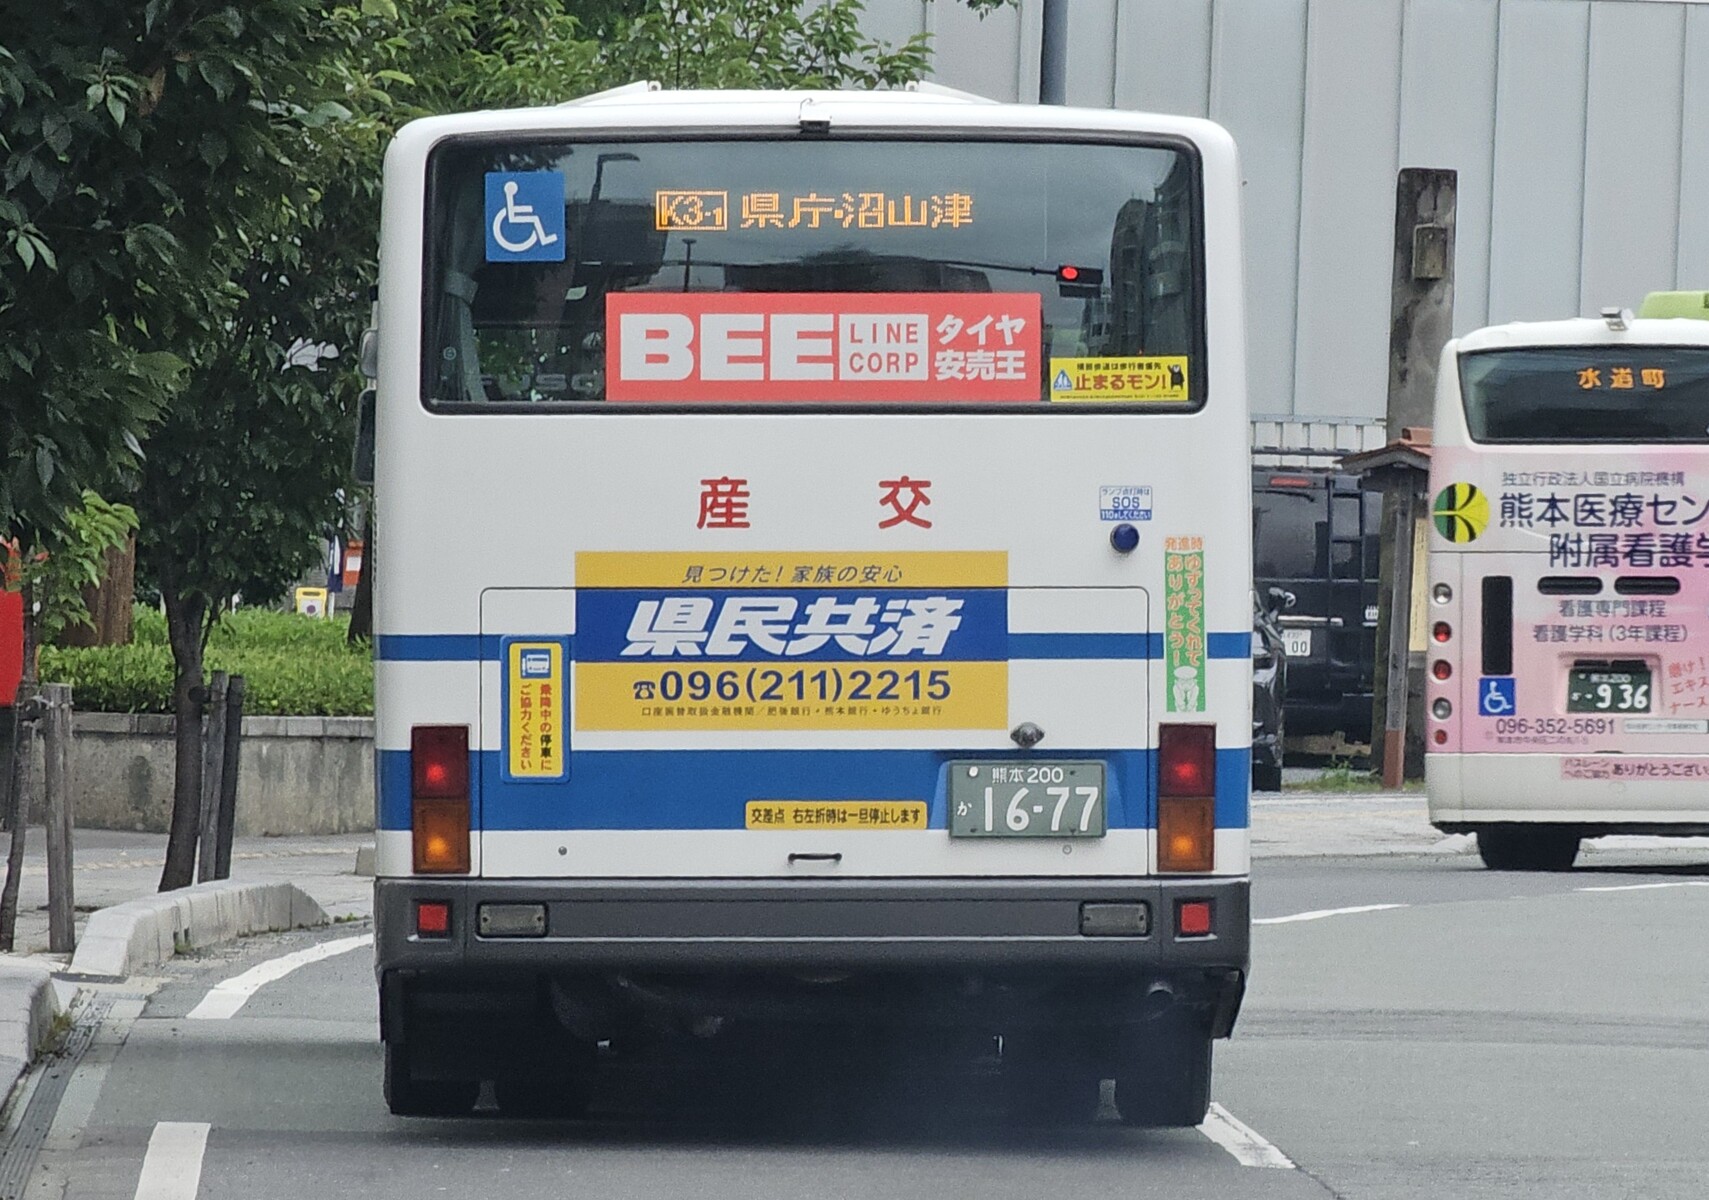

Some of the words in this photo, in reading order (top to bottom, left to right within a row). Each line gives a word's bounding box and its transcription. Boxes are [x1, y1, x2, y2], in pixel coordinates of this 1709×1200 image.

[660, 195, 723, 226] K3-1
[741, 192, 973, 228] 県庁・沼山津
[850, 323, 919, 344] LINE
[935, 314, 1026, 345] タイヤ
[620, 314, 834, 381] BEE
[850, 352, 919, 373] CORP
[935, 350, 1026, 380] 安売王
[1576, 367, 1665, 389] 水道町
[1075, 374, 1166, 391] 止まるモン!
[697, 476, 750, 529] 産
[878, 475, 932, 529] 交
[1112, 496, 1140, 509] SOS
[620, 596, 964, 656] 県民共済
[660, 668, 952, 702] 096(211)2215
[520, 683, 532, 771] ご協力ください
[1496, 718, 1614, 734] 096-352-5691
[992, 767, 1064, 784] 熊本200
[751, 808, 785, 825] 交差点
[792, 808, 921, 825] 右左折時は一旦停止します
[957, 801, 973, 817] か
[983, 786, 1099, 832] 16-77
